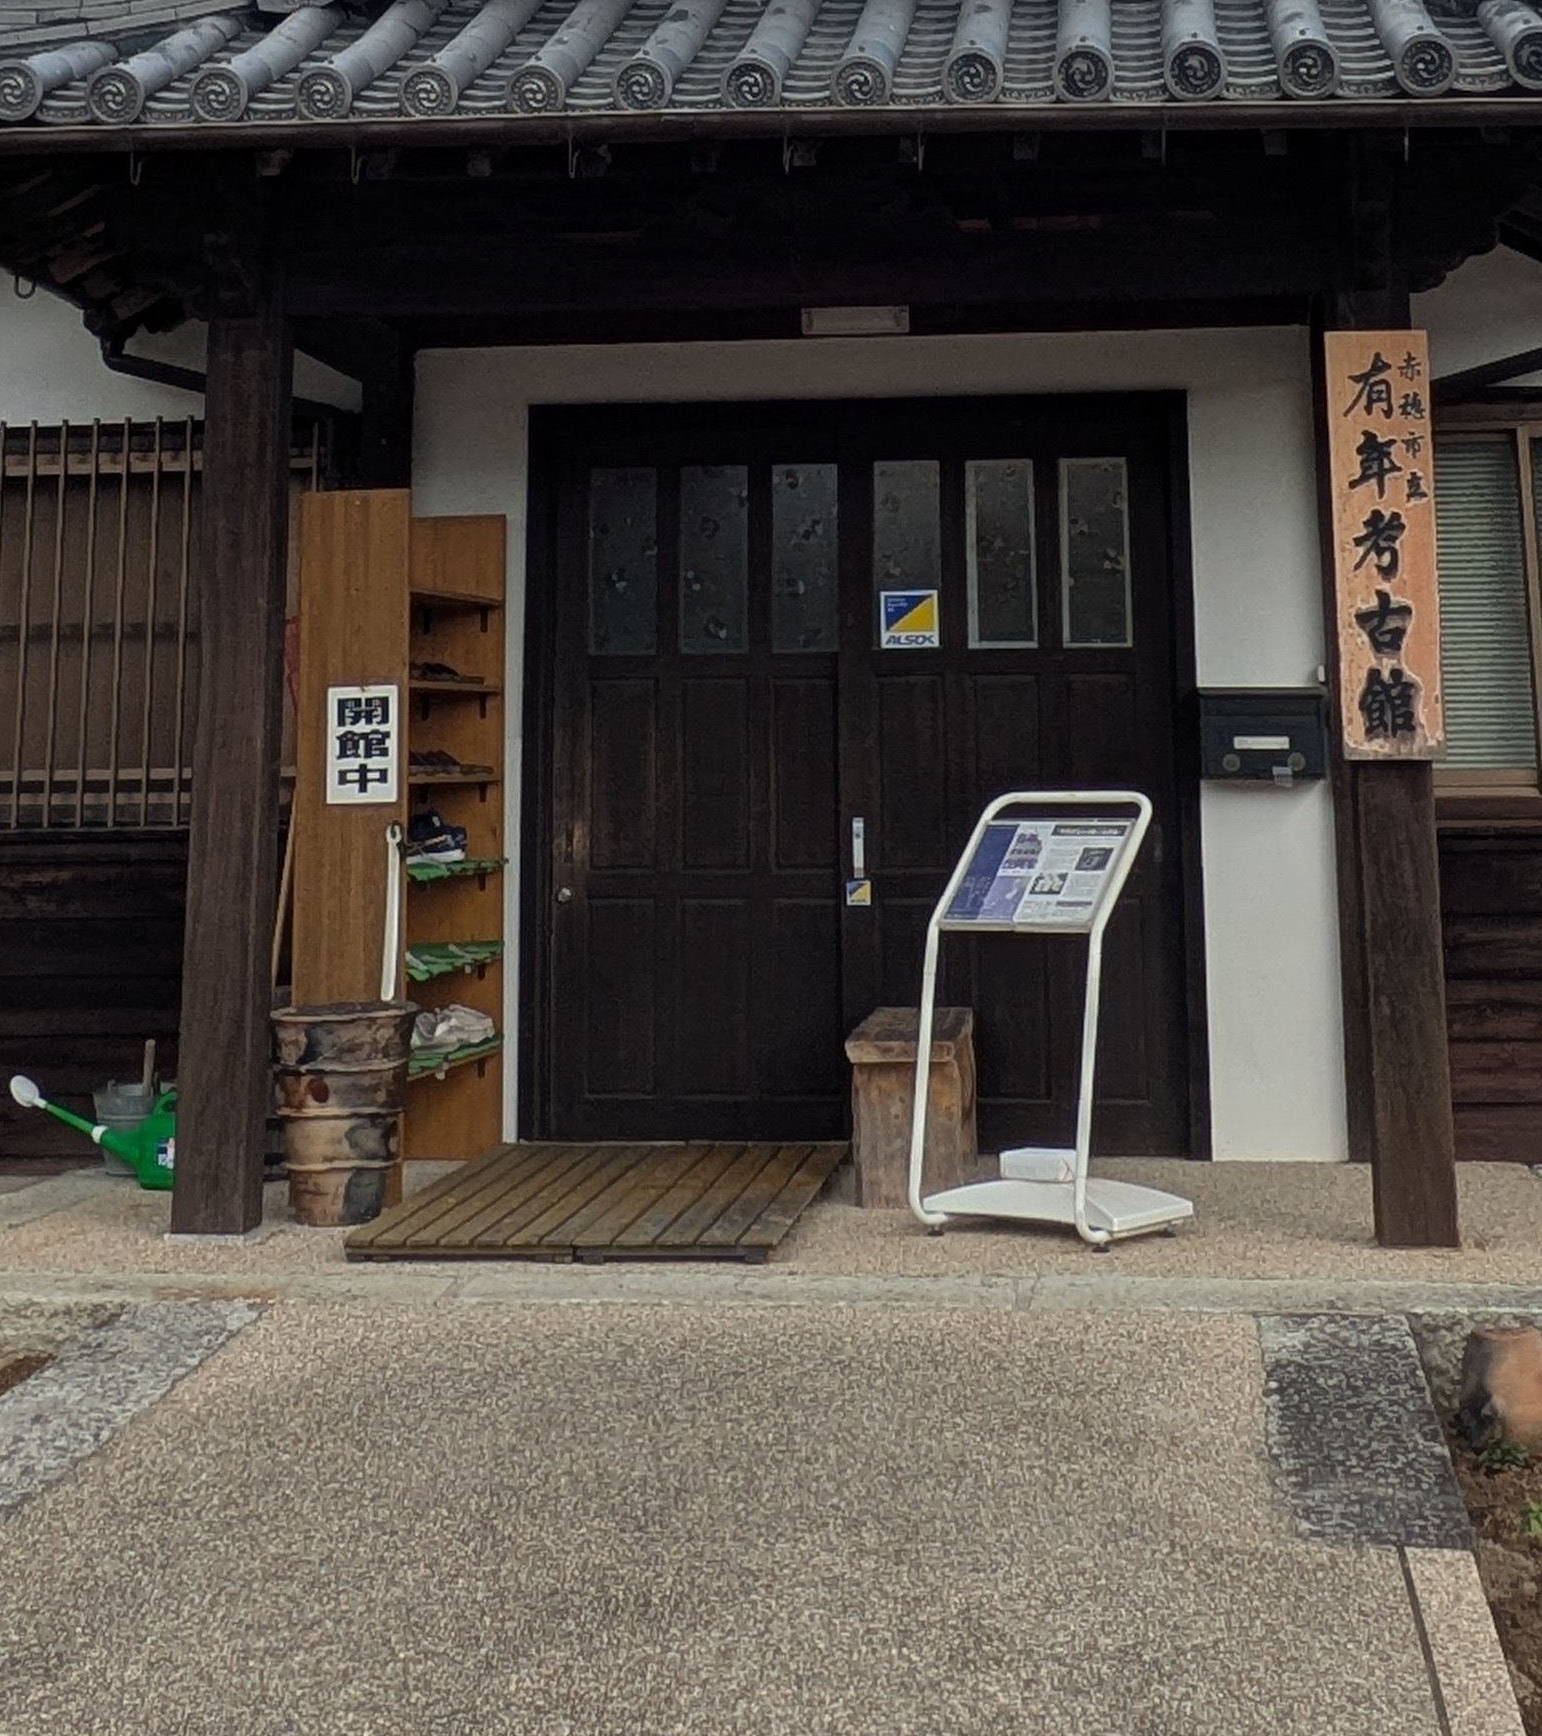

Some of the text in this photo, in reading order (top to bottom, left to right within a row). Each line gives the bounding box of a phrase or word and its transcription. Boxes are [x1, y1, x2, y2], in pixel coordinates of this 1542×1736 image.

[1396, 351, 1429, 502] 赤穂市立
[1342, 350, 1419, 739] 有年考古館
[885, 634, 935, 646] ALSOK
[335, 695, 391, 794] 開館中
